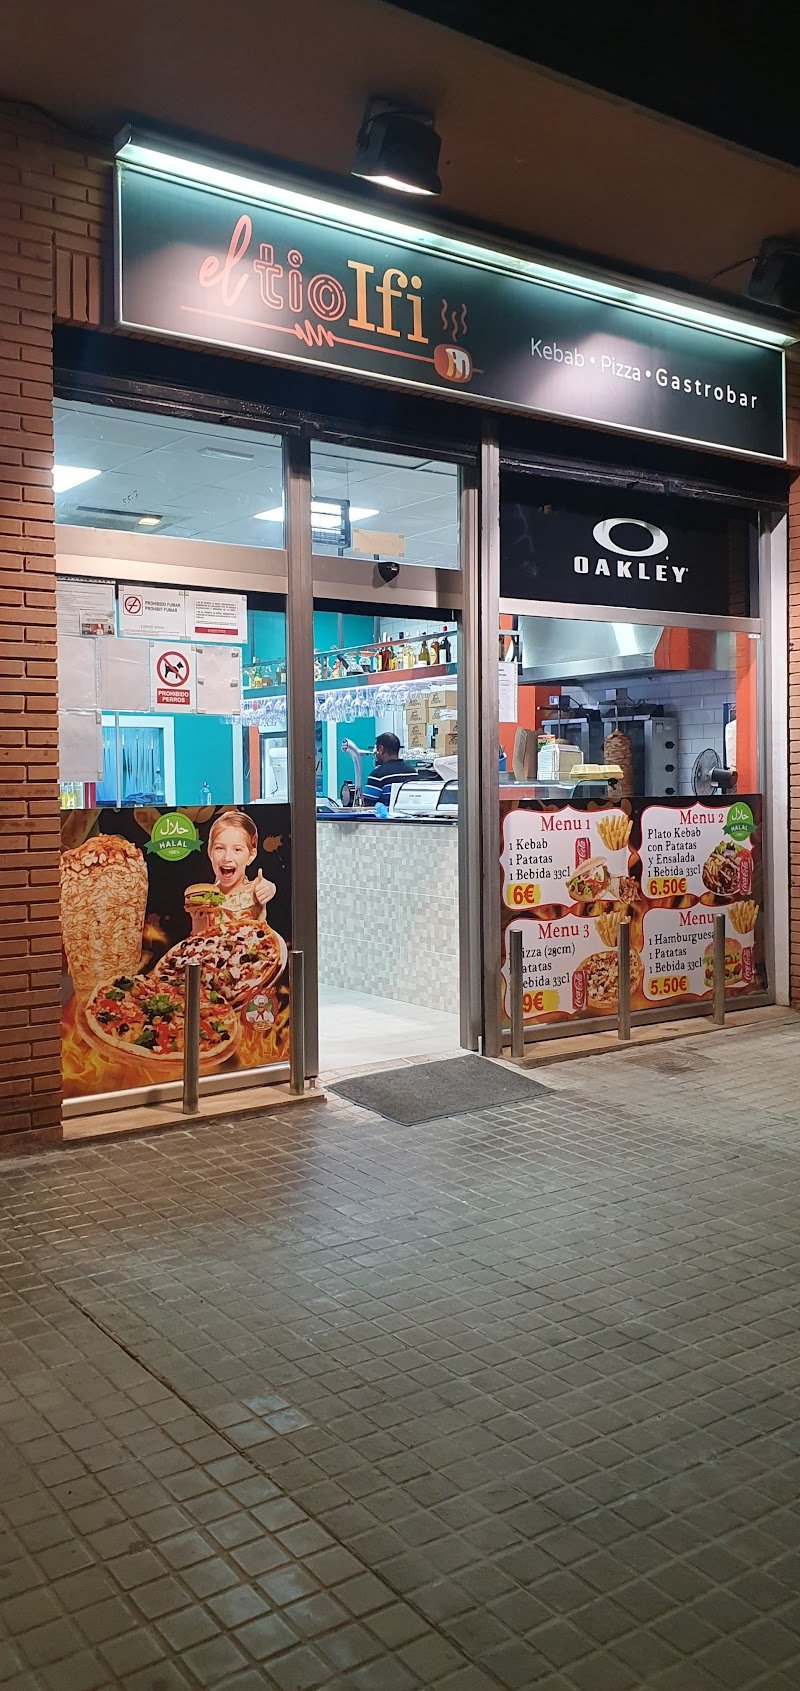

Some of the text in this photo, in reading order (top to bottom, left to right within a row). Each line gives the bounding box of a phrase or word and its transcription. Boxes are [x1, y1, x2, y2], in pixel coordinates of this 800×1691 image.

[530, 337, 758, 409] Kebab Pizza Gastrobar
[573, 555, 685, 584] OAKLEY
[158, 690, 190, 698] PROHIBIDO
[162, 696, 186, 704] PERROS
[540, 815, 591, 832] Menu 1
[679, 809, 724, 825] Menu 2
[159, 818, 189, 835] حلال
[647, 827, 701, 839] Plato Kebab
[731, 824, 748, 832] HALAL
[159, 840, 188, 849] HALAL
[509, 838, 548, 850] 1 Kebab
[647, 841, 697, 852] con Patatas
[509, 853, 553, 865] 1 Patatas
[648, 852, 695, 868] y Ensalada
[509, 866, 571, 880] 1 Bebida 33cl
[654, 866, 684, 877] Bebida
[686, 864, 701, 876] 33cl
[649, 877, 687, 896] 6.50€
[512, 884, 535, 905] 6€
[679, 911, 715, 927] Menu
[538, 922, 590, 940] Menu 3
[522, 942, 576, 959] izza (28cm)
[655, 947, 687, 959] Patatas
[522, 962, 552, 973] atatas
[655, 961, 685, 973] Bebida
[687, 958, 703, 971] 33cl
[522, 972, 570, 988] ebida 33cl
[650, 975, 687, 996] 5.50€
